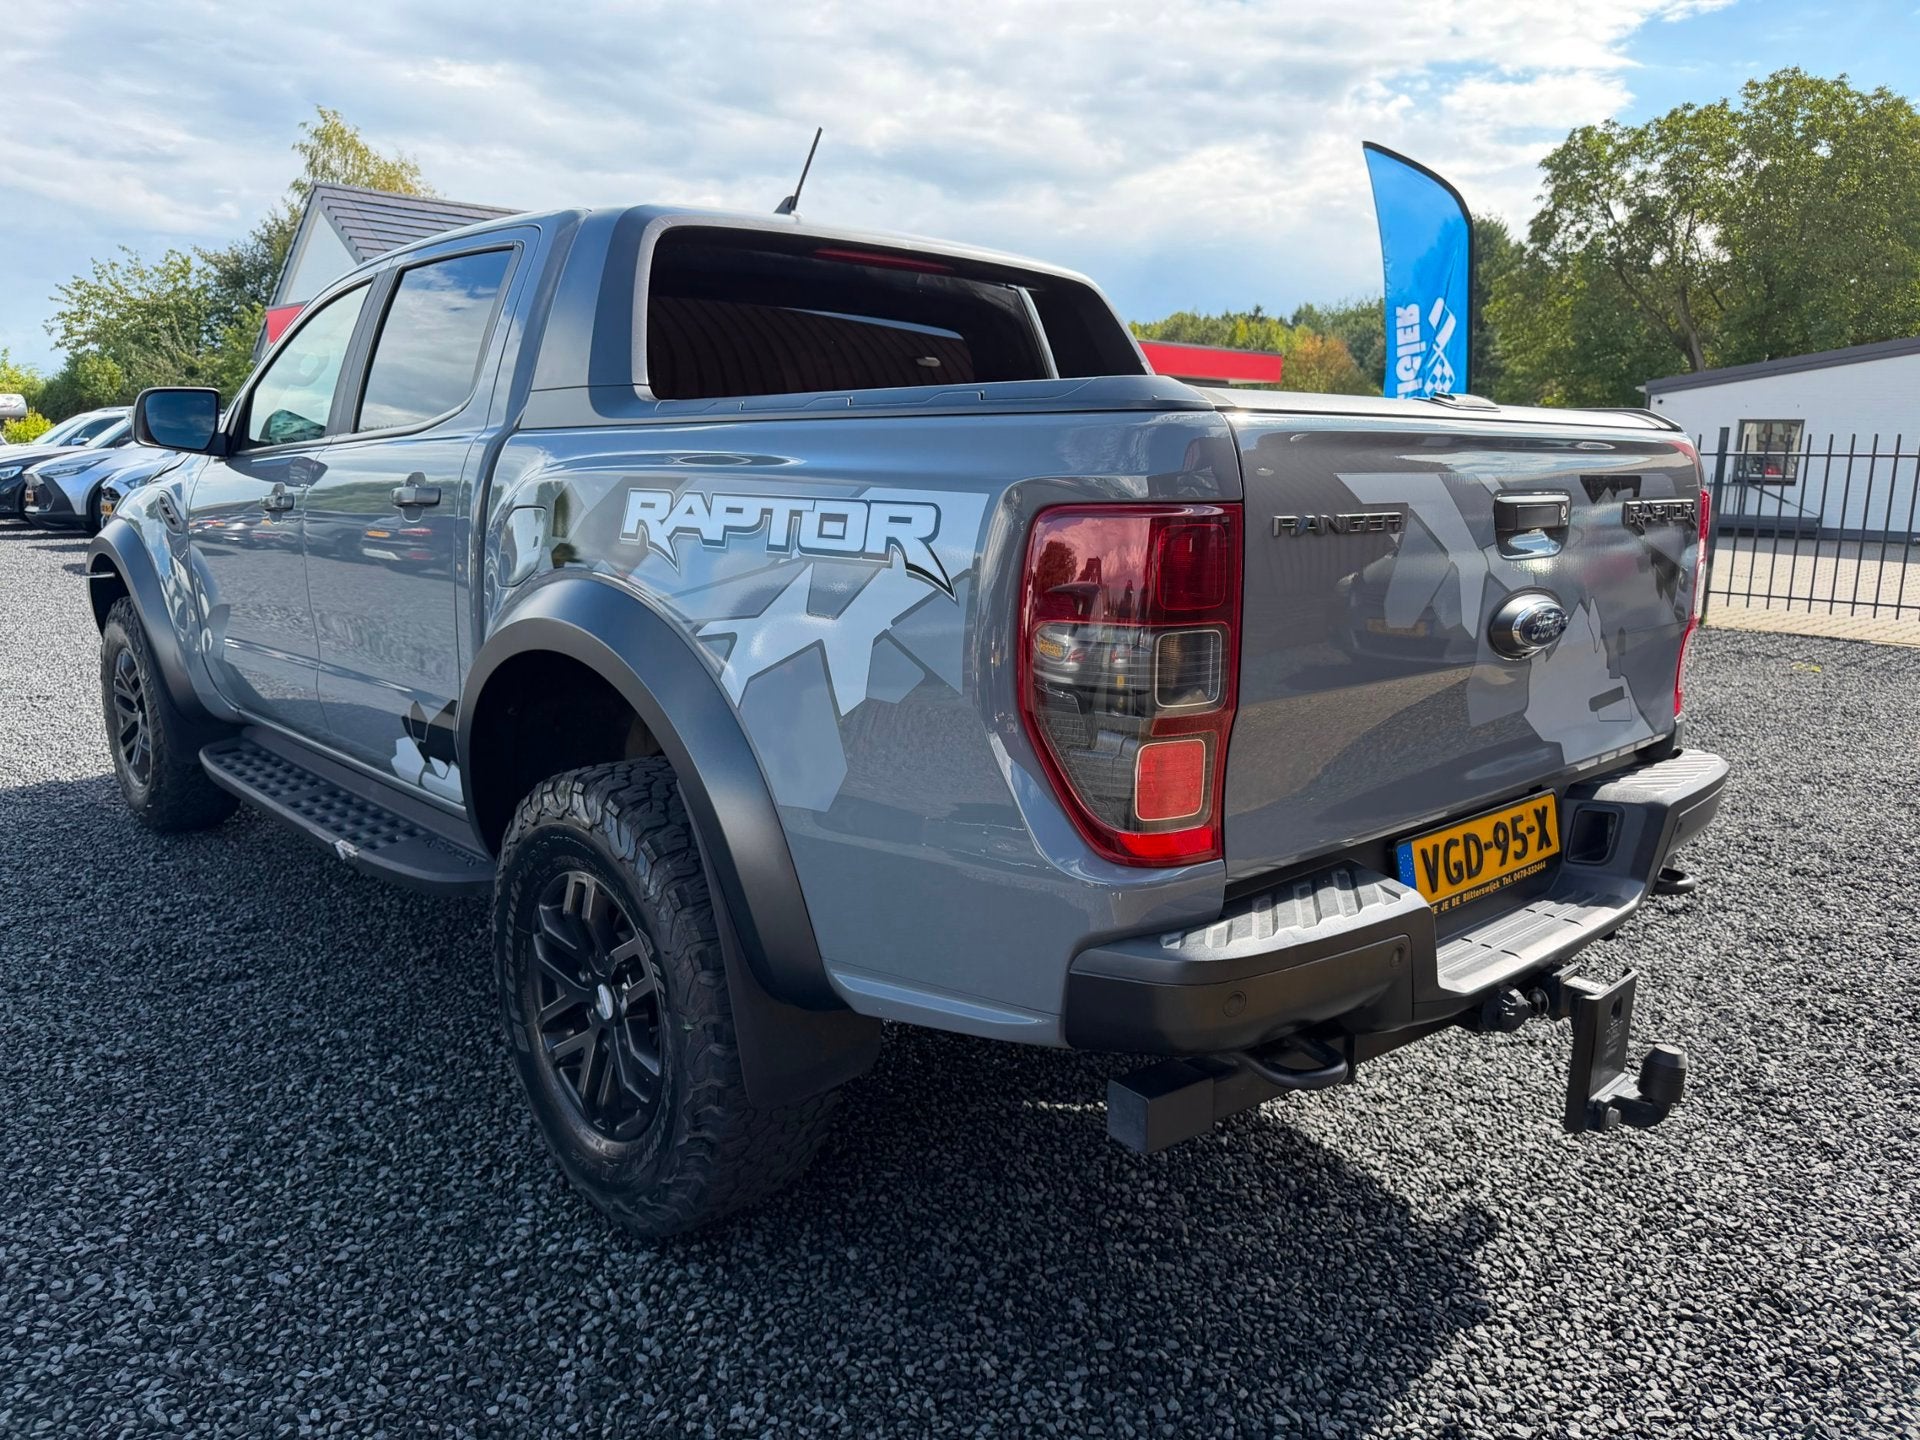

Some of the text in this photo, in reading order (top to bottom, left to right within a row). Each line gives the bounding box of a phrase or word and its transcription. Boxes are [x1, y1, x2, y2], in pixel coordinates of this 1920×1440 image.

[618, 488, 959, 606] RAPTOR
[1273, 512, 1402, 536] RANGER
[1623, 499, 1697, 534] RAPTOR
[1420, 806, 1553, 894] VGD-95-X
